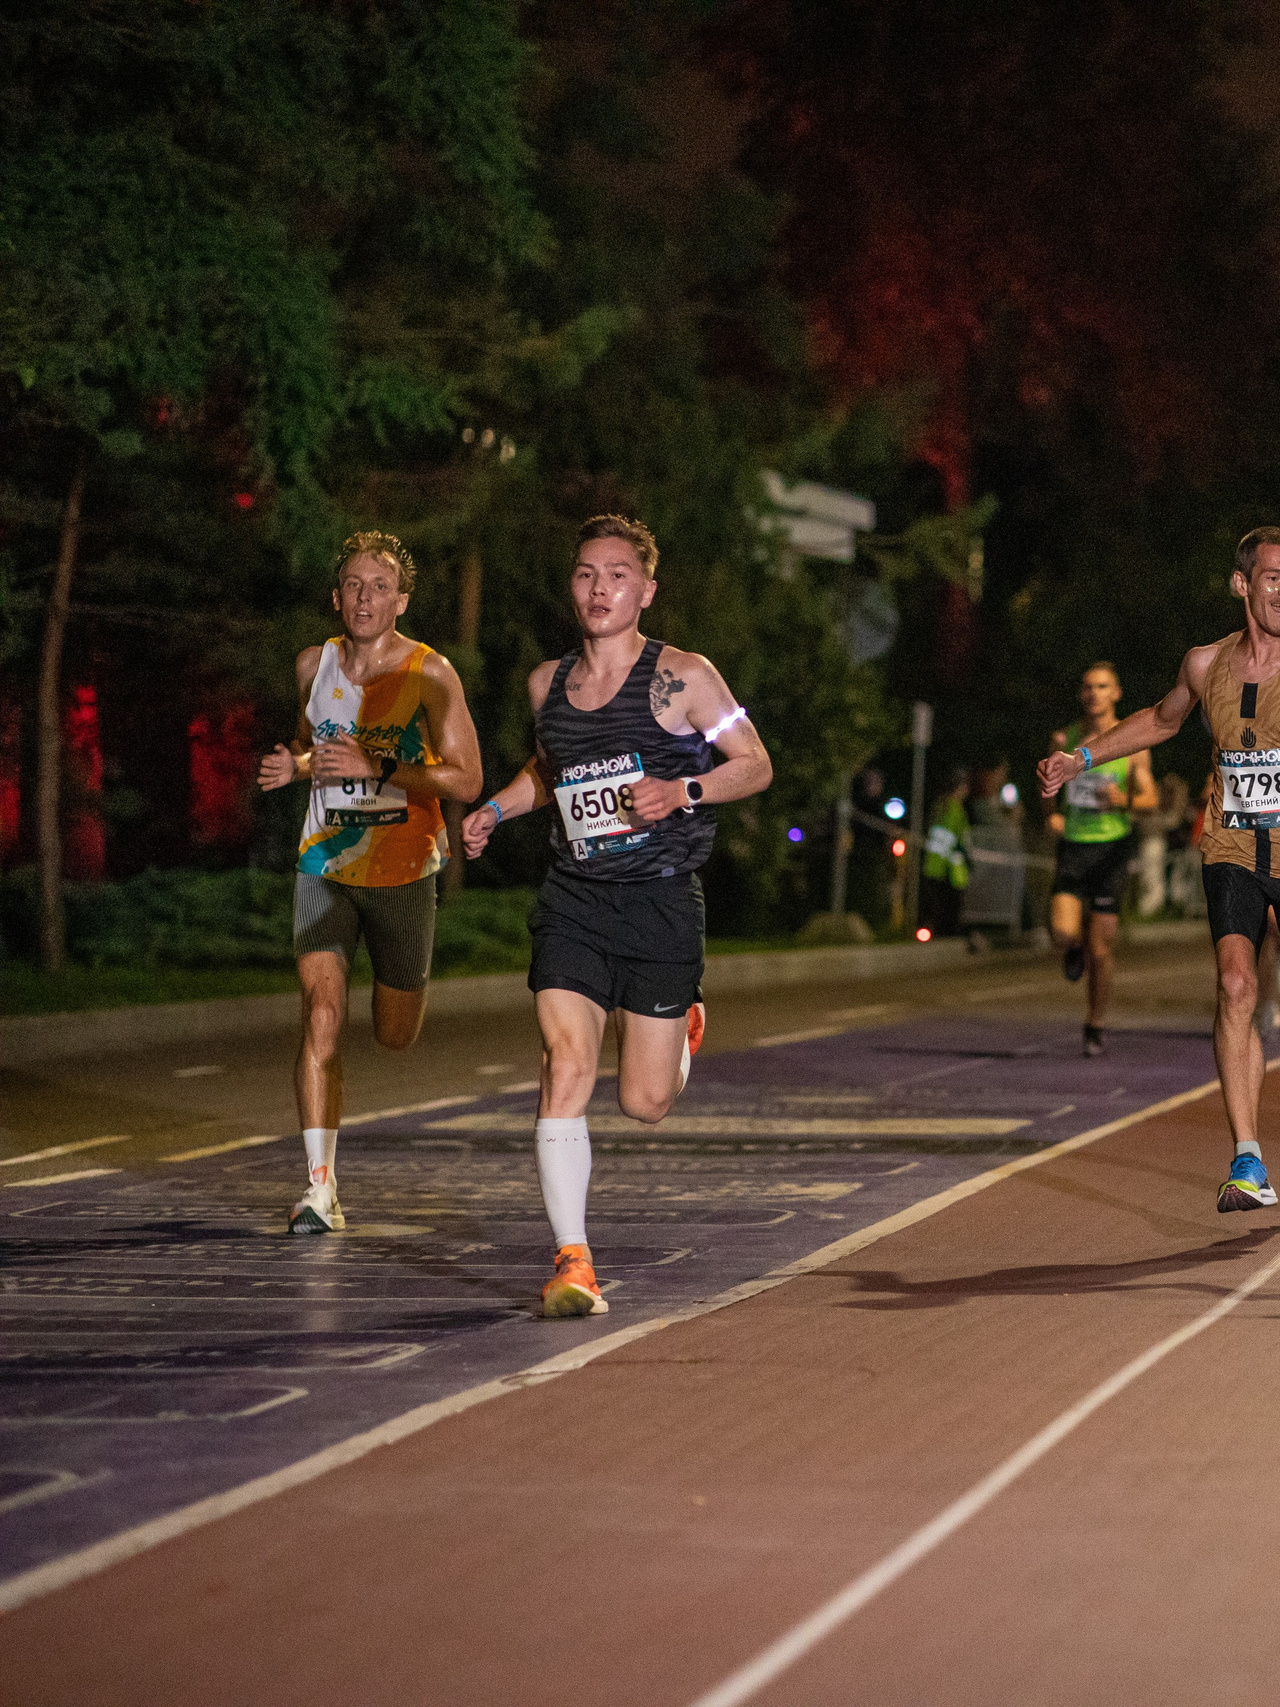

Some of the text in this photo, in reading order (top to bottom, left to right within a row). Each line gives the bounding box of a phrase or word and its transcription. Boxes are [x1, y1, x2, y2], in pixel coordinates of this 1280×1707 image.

[562, 753, 634, 782] НОЧНОЙ
[350, 797, 377, 806] ЛЕВОН
[570, 783, 635, 821] 6508
[1240, 796, 1279, 809] ЕВГЕНИЙ
[587, 817, 624, 831] НИКИТА
